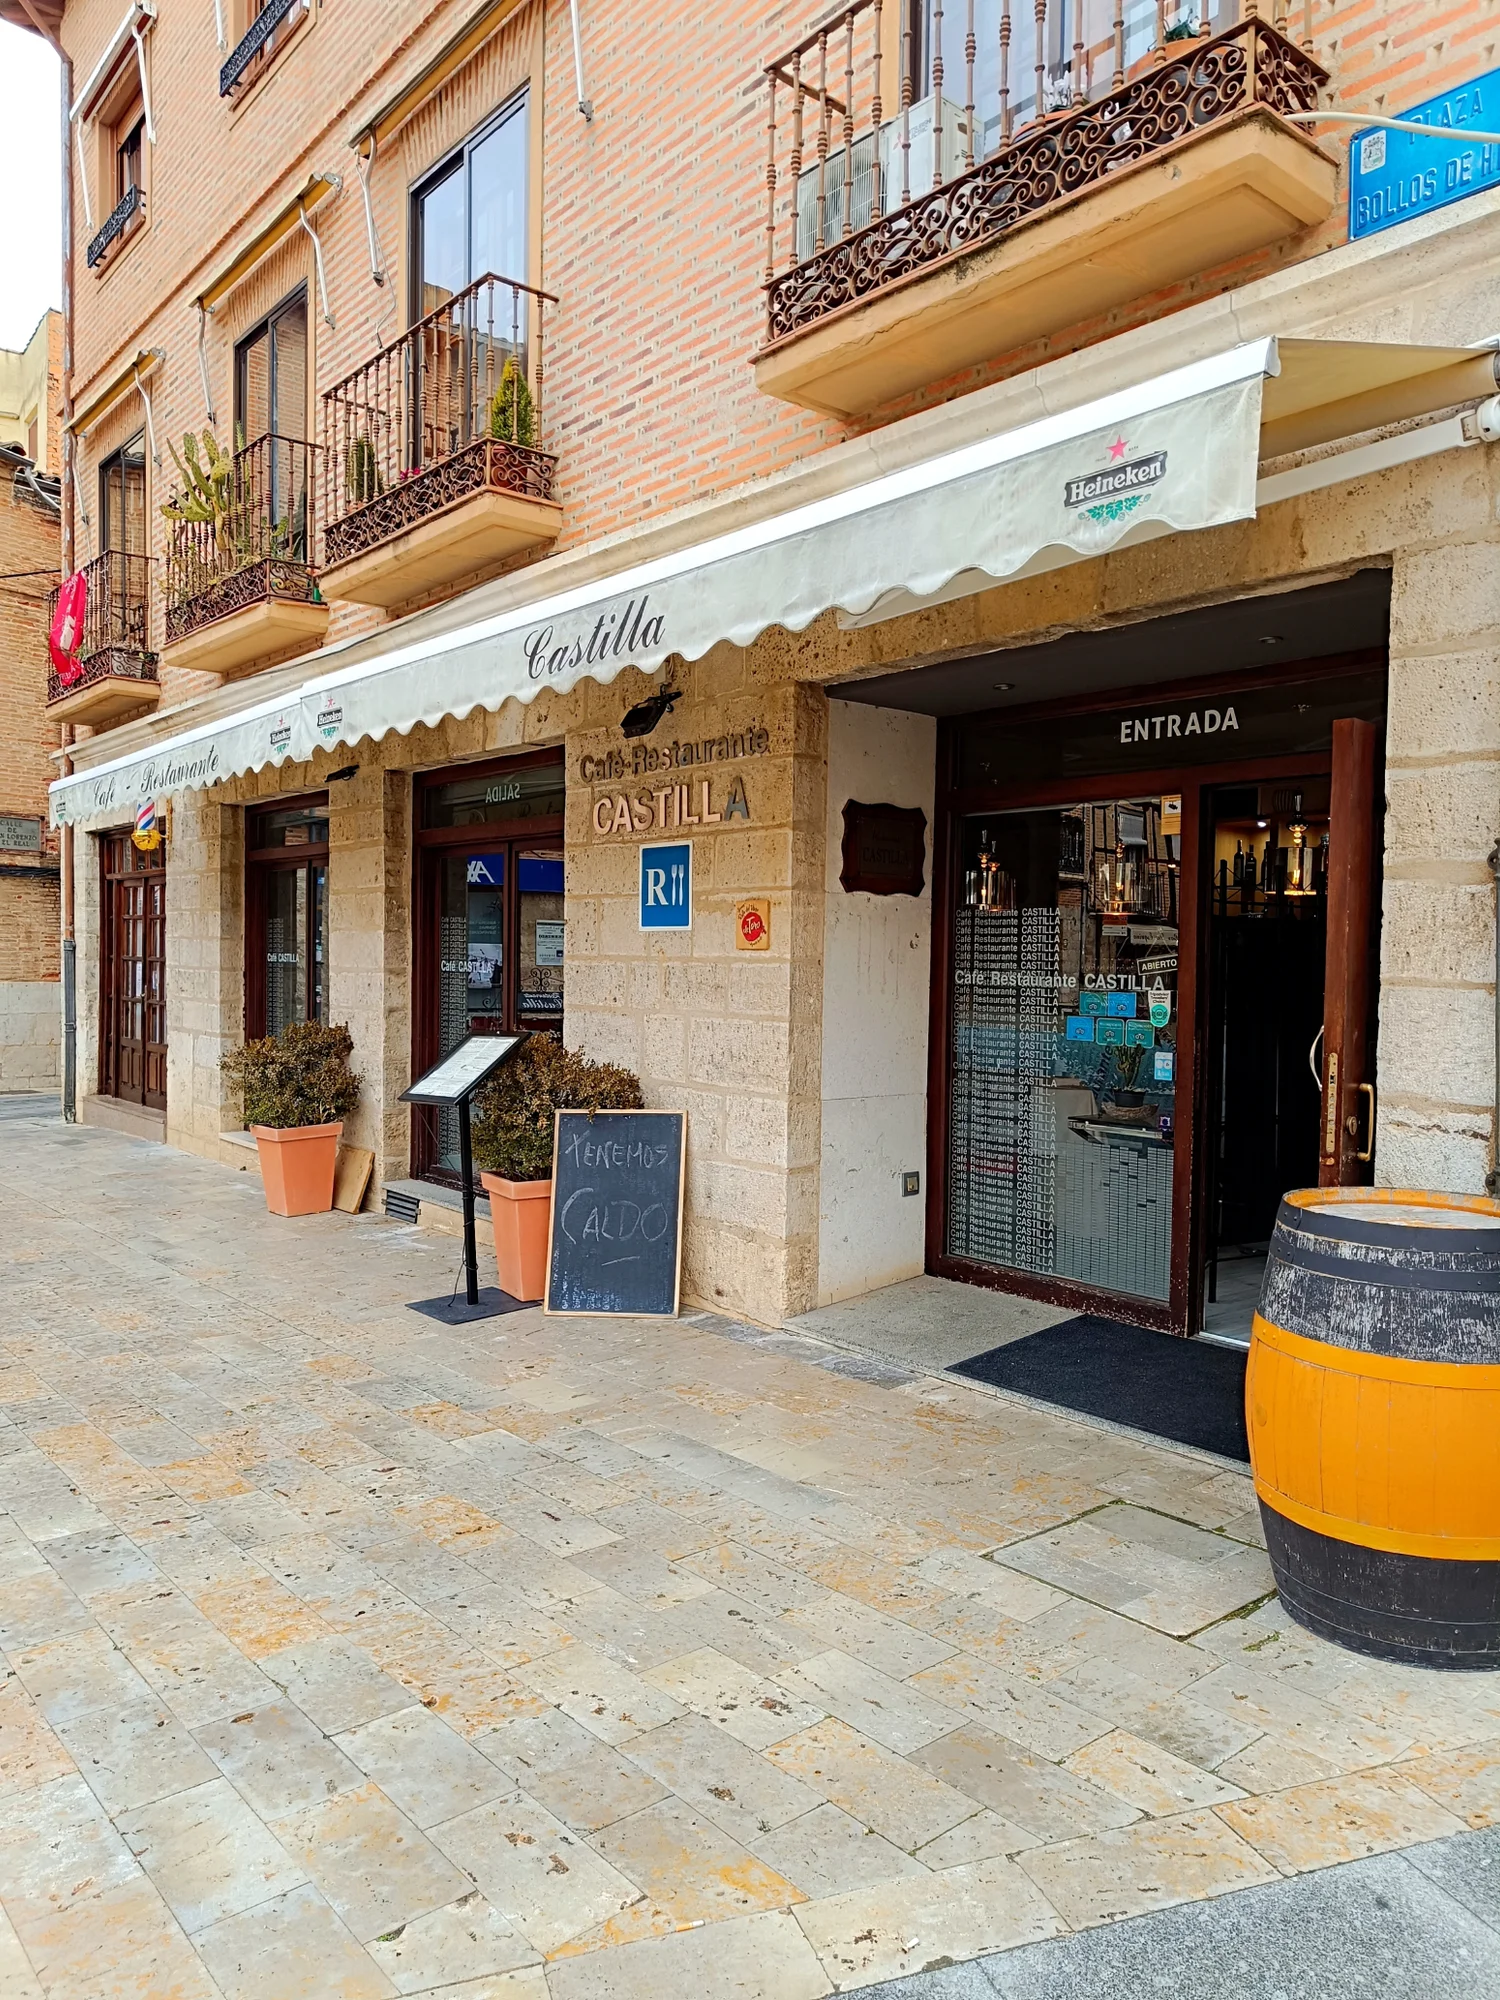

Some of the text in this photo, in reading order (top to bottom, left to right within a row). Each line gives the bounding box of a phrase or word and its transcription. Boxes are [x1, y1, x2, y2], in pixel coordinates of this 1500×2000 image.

[1408, 88, 1484, 145] PLAZA
[1356, 140, 1500, 229] BOLLOS DE H
[1069, 461, 1162, 503] Heineken
[523, 595, 666, 679] Castilla
[1120, 706, 1239, 743] ENTRADA
[93, 777, 115, 809] Café
[141, 745, 219, 793] Restaurante
[592, 776, 750, 836] CASTILLA
[645, 868, 669, 906] R
[956, 910, 972, 918] Café
[441, 960, 456, 971] Café
[974, 961, 1017, 969] Restaurante
[1142, 958, 1177, 971] ABIERTO
[955, 970, 984, 986] Café
[991, 971, 1077, 988] Restaurante
[1084, 973, 1165, 990] CASTILLA
[973, 987, 1016, 995] Restaurante
[1020, 988, 1058, 997] CASTILLA
[973, 995, 1016, 1004] Restaurante
[1020, 997, 1058, 1006] CASTILLA
[973, 1004, 1016, 1013] Restaurante
[1020, 1006, 1058, 1015] CASTILLA
[973, 1012, 1016, 1022] Restaurante
[1020, 1015, 1058, 1024] CASTILLA
[973, 1021, 1016, 1031] Restaurante
[1020, 1024, 1058, 1033] CASTILLA
[973, 1030, 1015, 1040] Restaurante
[1019, 1033, 1057, 1042] CASTILLA
[972, 1047, 1015, 1057] Restaurante
[1019, 1050, 1057, 1060] CASTILLA
[973, 1038, 1015, 1048] Restaurante
[1019, 1042, 1057, 1051] CASTILLA
[972, 1064, 1015, 1074] Restaurante
[972, 1072, 1056, 1087] Restaurante CASTILLA
[972, 1089, 1014, 1101] Restaurante
[971, 1106, 1014, 1118] Restaurante
[1018, 1112, 1056, 1123] CASTILLA
[972, 1098, 1014, 1110] Restaurante
[1018, 1104, 1056, 1114] CASTILLA
[971, 1115, 1014, 1127] Restaurante
[1018, 1121, 1056, 1132] CASTILLA
[971, 1123, 1014, 1135] Restaurante
[1018, 1130, 1055, 1141] CASTILLA
[565, 1130, 669, 1169] TENEMOS
[971, 1132, 1014, 1144] Restaurante
[1018, 1139, 1055, 1150] CASTILLA
[971, 1140, 1013, 1152] Restaurante
[1017, 1147, 1055, 1158] CASTILLA
[970, 1149, 1013, 1161] Restaurante
[1017, 1156, 1055, 1168] CASTILLA
[970, 1157, 1013, 1170] Restaurante
[1017, 1165, 1055, 1177] CASTILLA
[952, 1163, 1054, 1186] Café Restaurante CASTILLA
[952, 1172, 1054, 1195] Café Restaurante CASTILLA
[951, 1180, 1054, 1204] Café Restaurante CASTILLA
[951, 1188, 1054, 1213] Café Restaurante CASTILLA
[561, 1187, 668, 1245] CALDO
[951, 1197, 1054, 1222] Café Restaurante CASTILLA
[951, 1205, 1054, 1231] Café Restaurante CASTILLA
[951, 1214, 1054, 1240] Café Restaurante CASTILLA
[951, 1222, 1053, 1249] Café Restaurante CASTILLA
[951, 1231, 1053, 1258] Café Restaurante CASTILLA
[951, 1239, 966, 1247] Café
[969, 1242, 1011, 1258] Restaurante
[1016, 1253, 1053, 1267] CASTILLA
